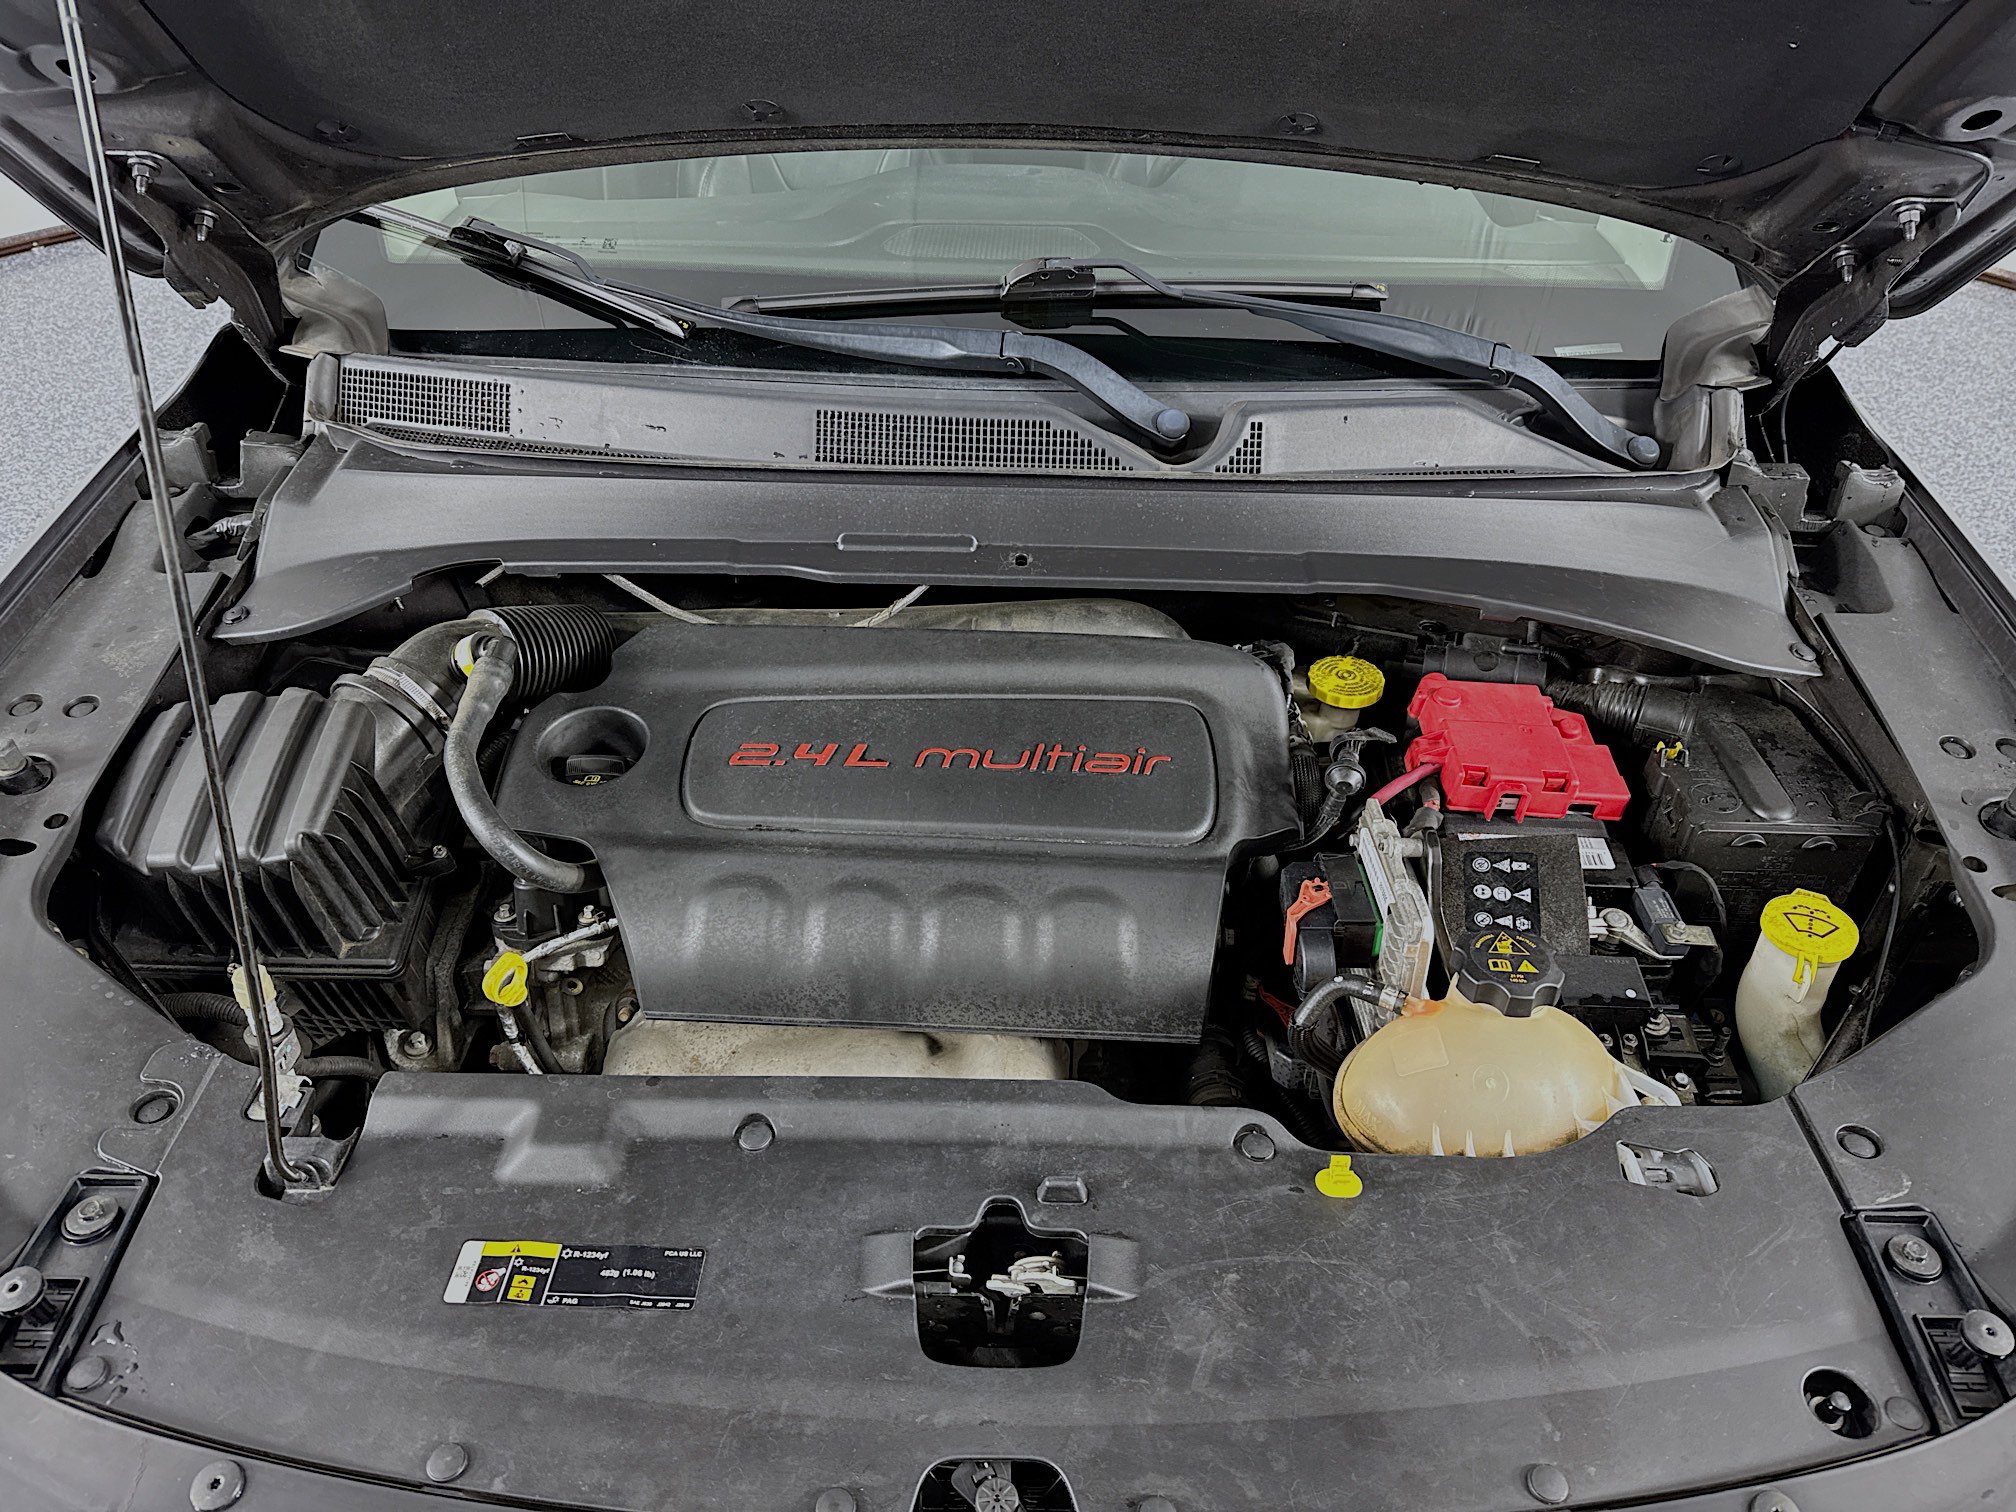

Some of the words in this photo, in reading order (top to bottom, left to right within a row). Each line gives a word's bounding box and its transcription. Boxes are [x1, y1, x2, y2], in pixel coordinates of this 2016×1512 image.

[914, 743, 1172, 776] multiair
[572, 1250, 610, 1260] R-1234yf
[689, 1250, 703, 1258] LLC
[561, 1297, 579, 1305] PAG
